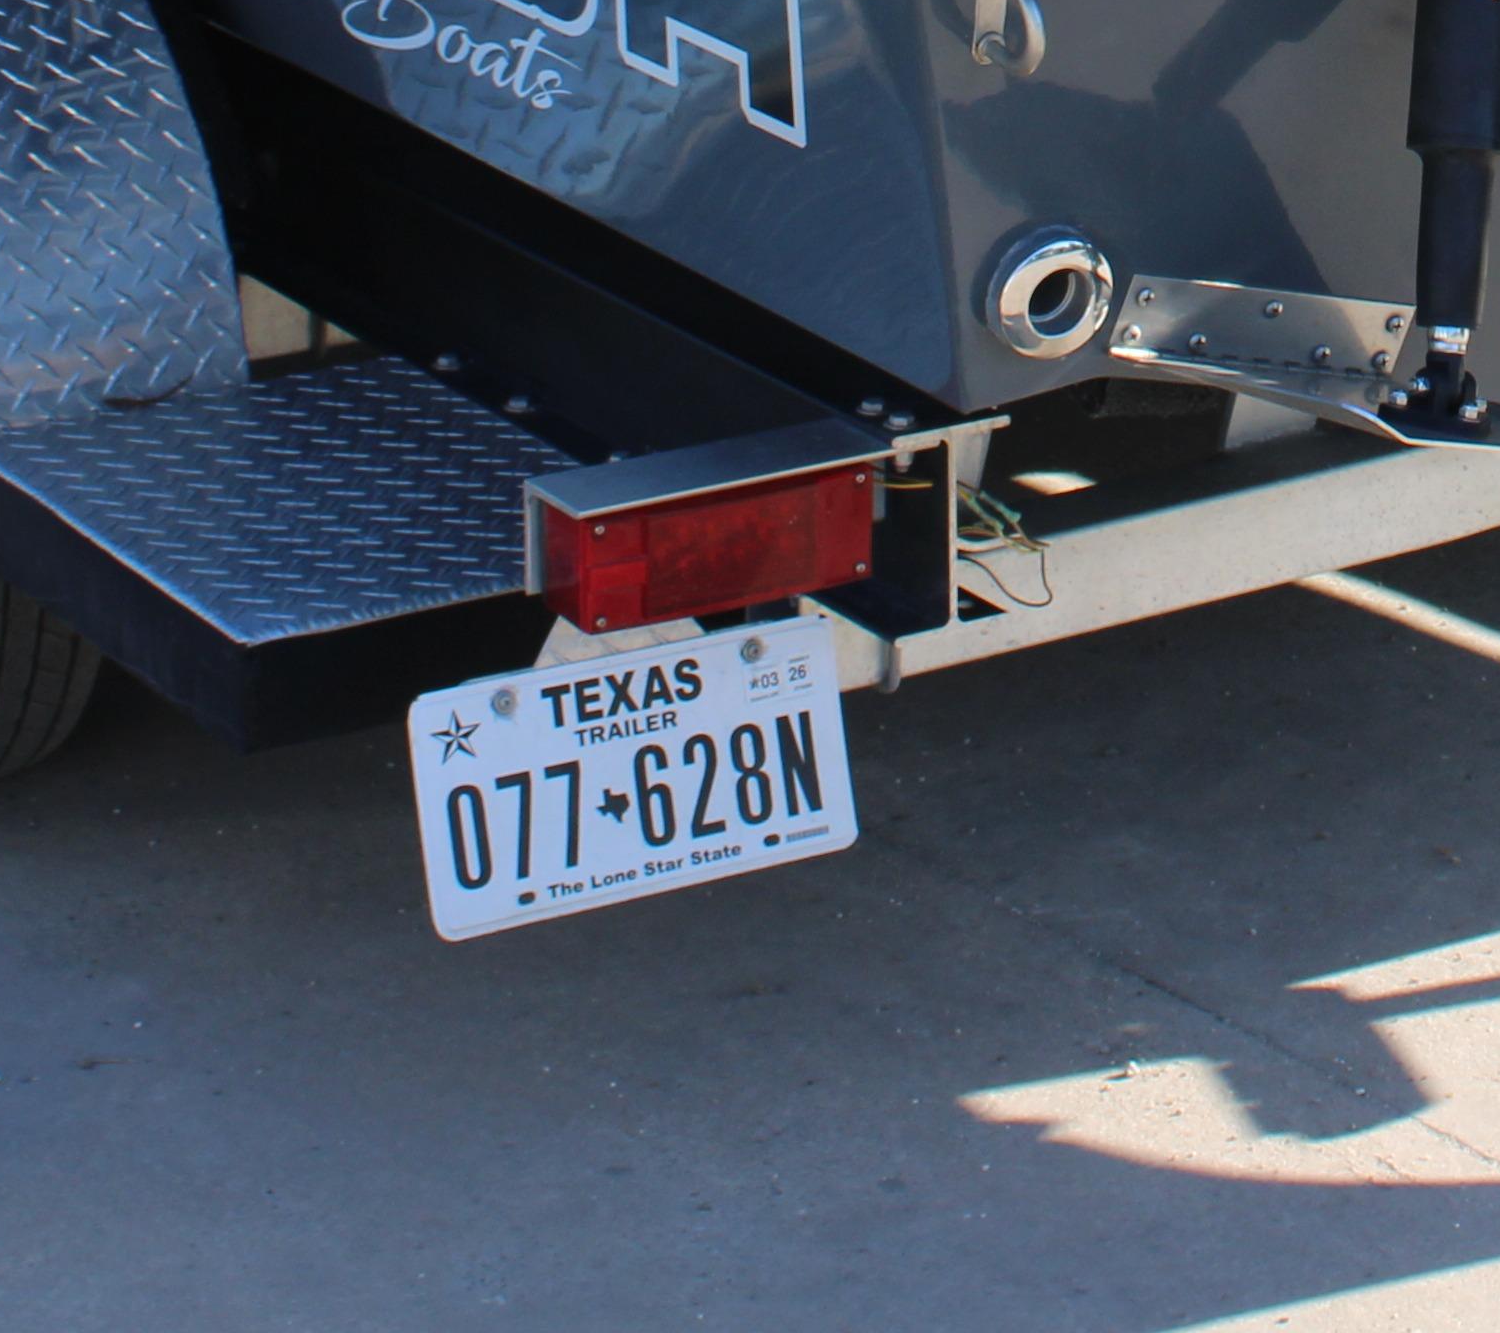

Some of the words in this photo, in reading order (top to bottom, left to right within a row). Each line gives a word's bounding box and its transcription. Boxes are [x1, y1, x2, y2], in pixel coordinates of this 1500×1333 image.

[541, 659, 702, 728] TEXAS
[788, 663, 808, 682] 26
[574, 711, 678, 748] TRAILER
[547, 882, 585, 901] The
[590, 868, 637, 890] Lone
[643, 856, 686, 879] Star
[690, 843, 742, 868] State
